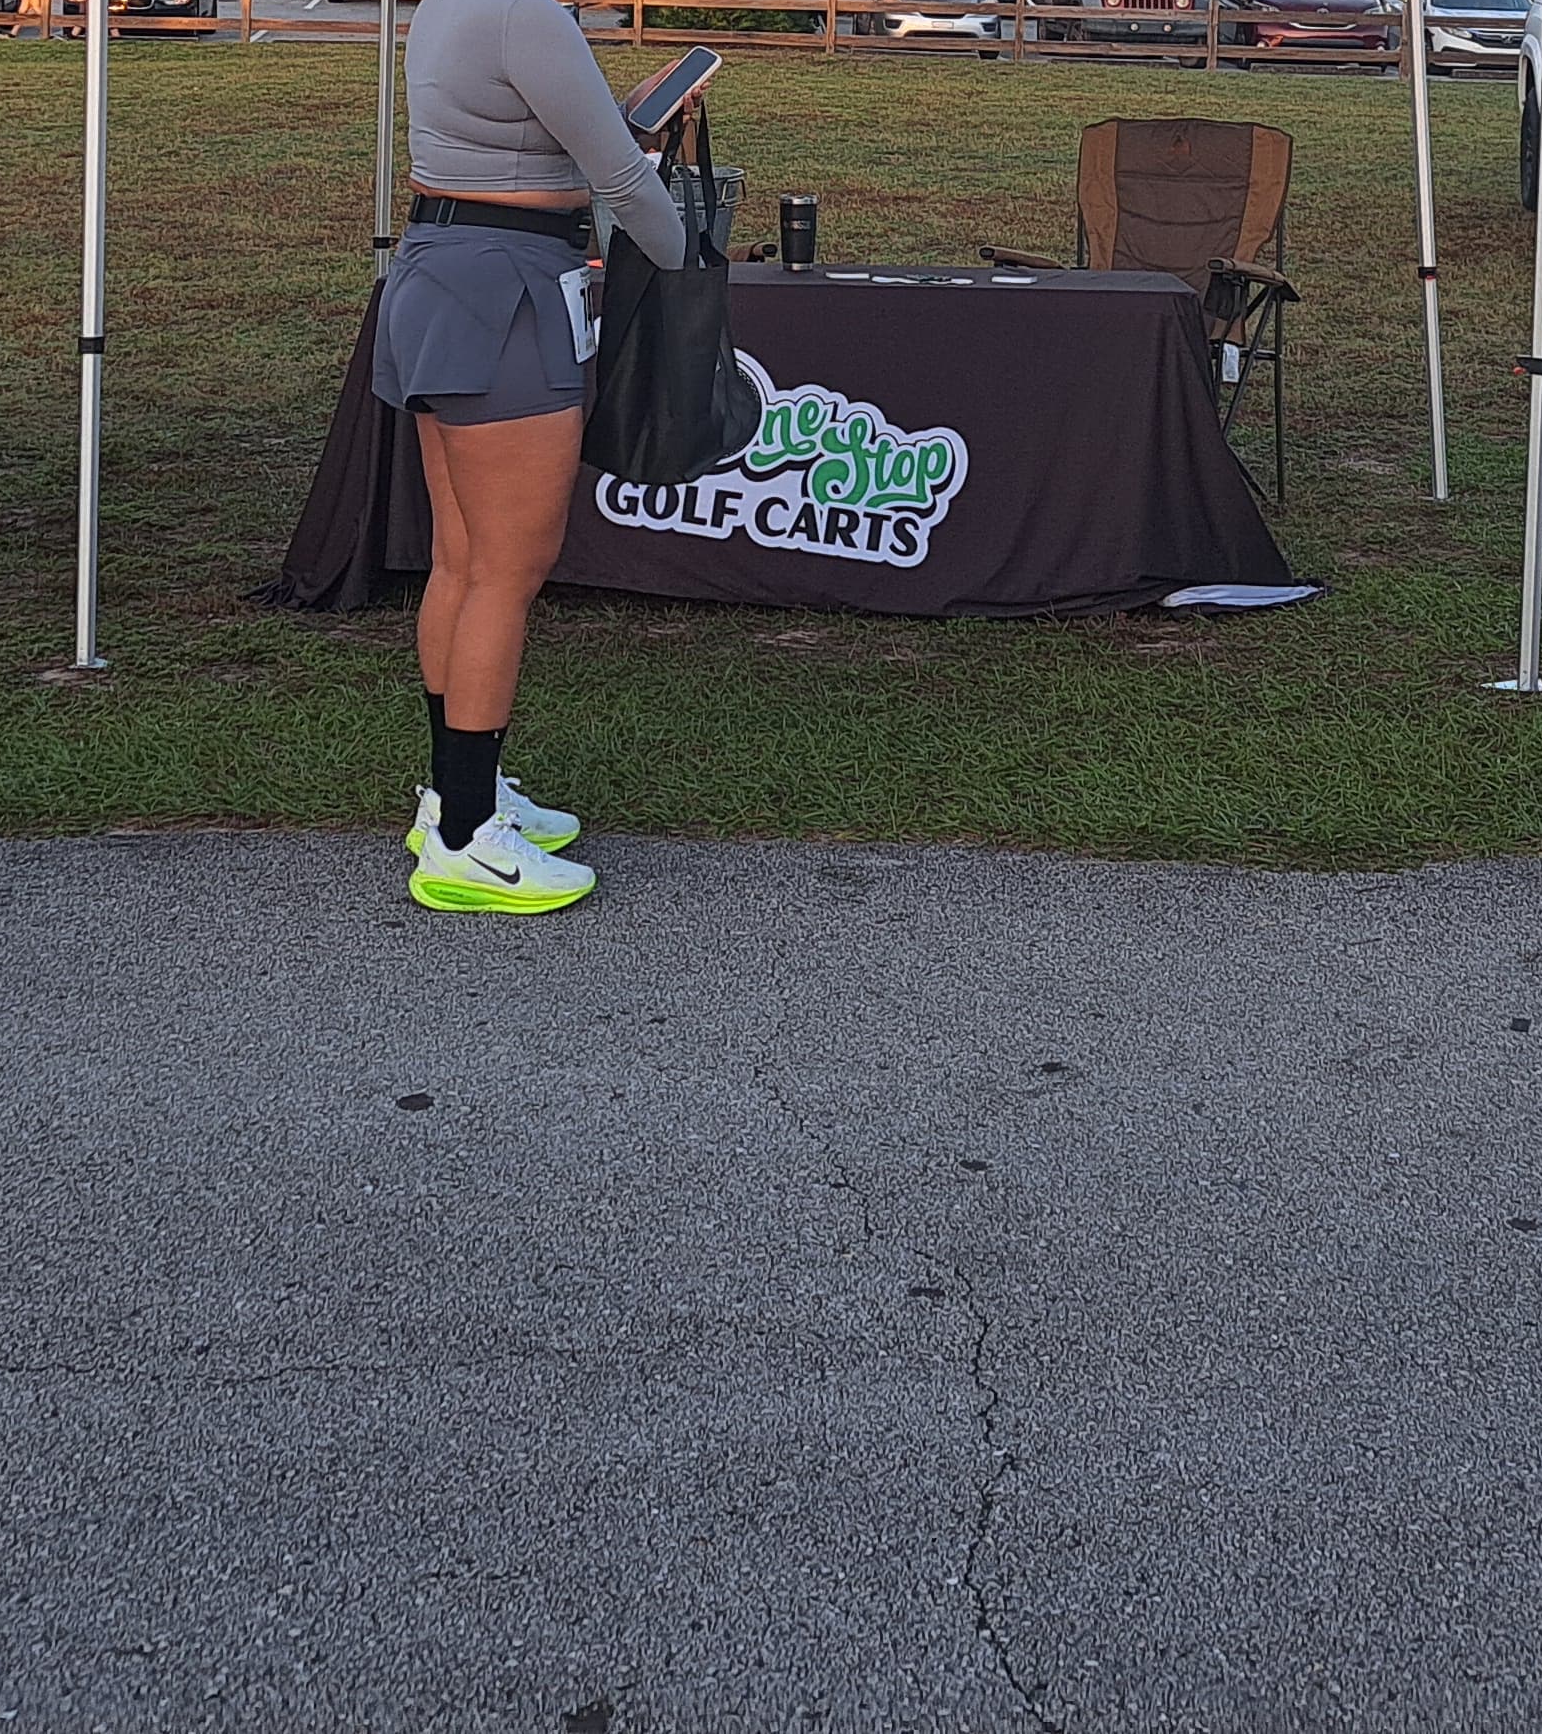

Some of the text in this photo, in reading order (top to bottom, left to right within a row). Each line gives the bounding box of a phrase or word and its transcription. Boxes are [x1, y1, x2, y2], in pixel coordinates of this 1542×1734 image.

[811, 417, 949, 509] Stop
[605, 480, 919, 557] GOLF CARTS
